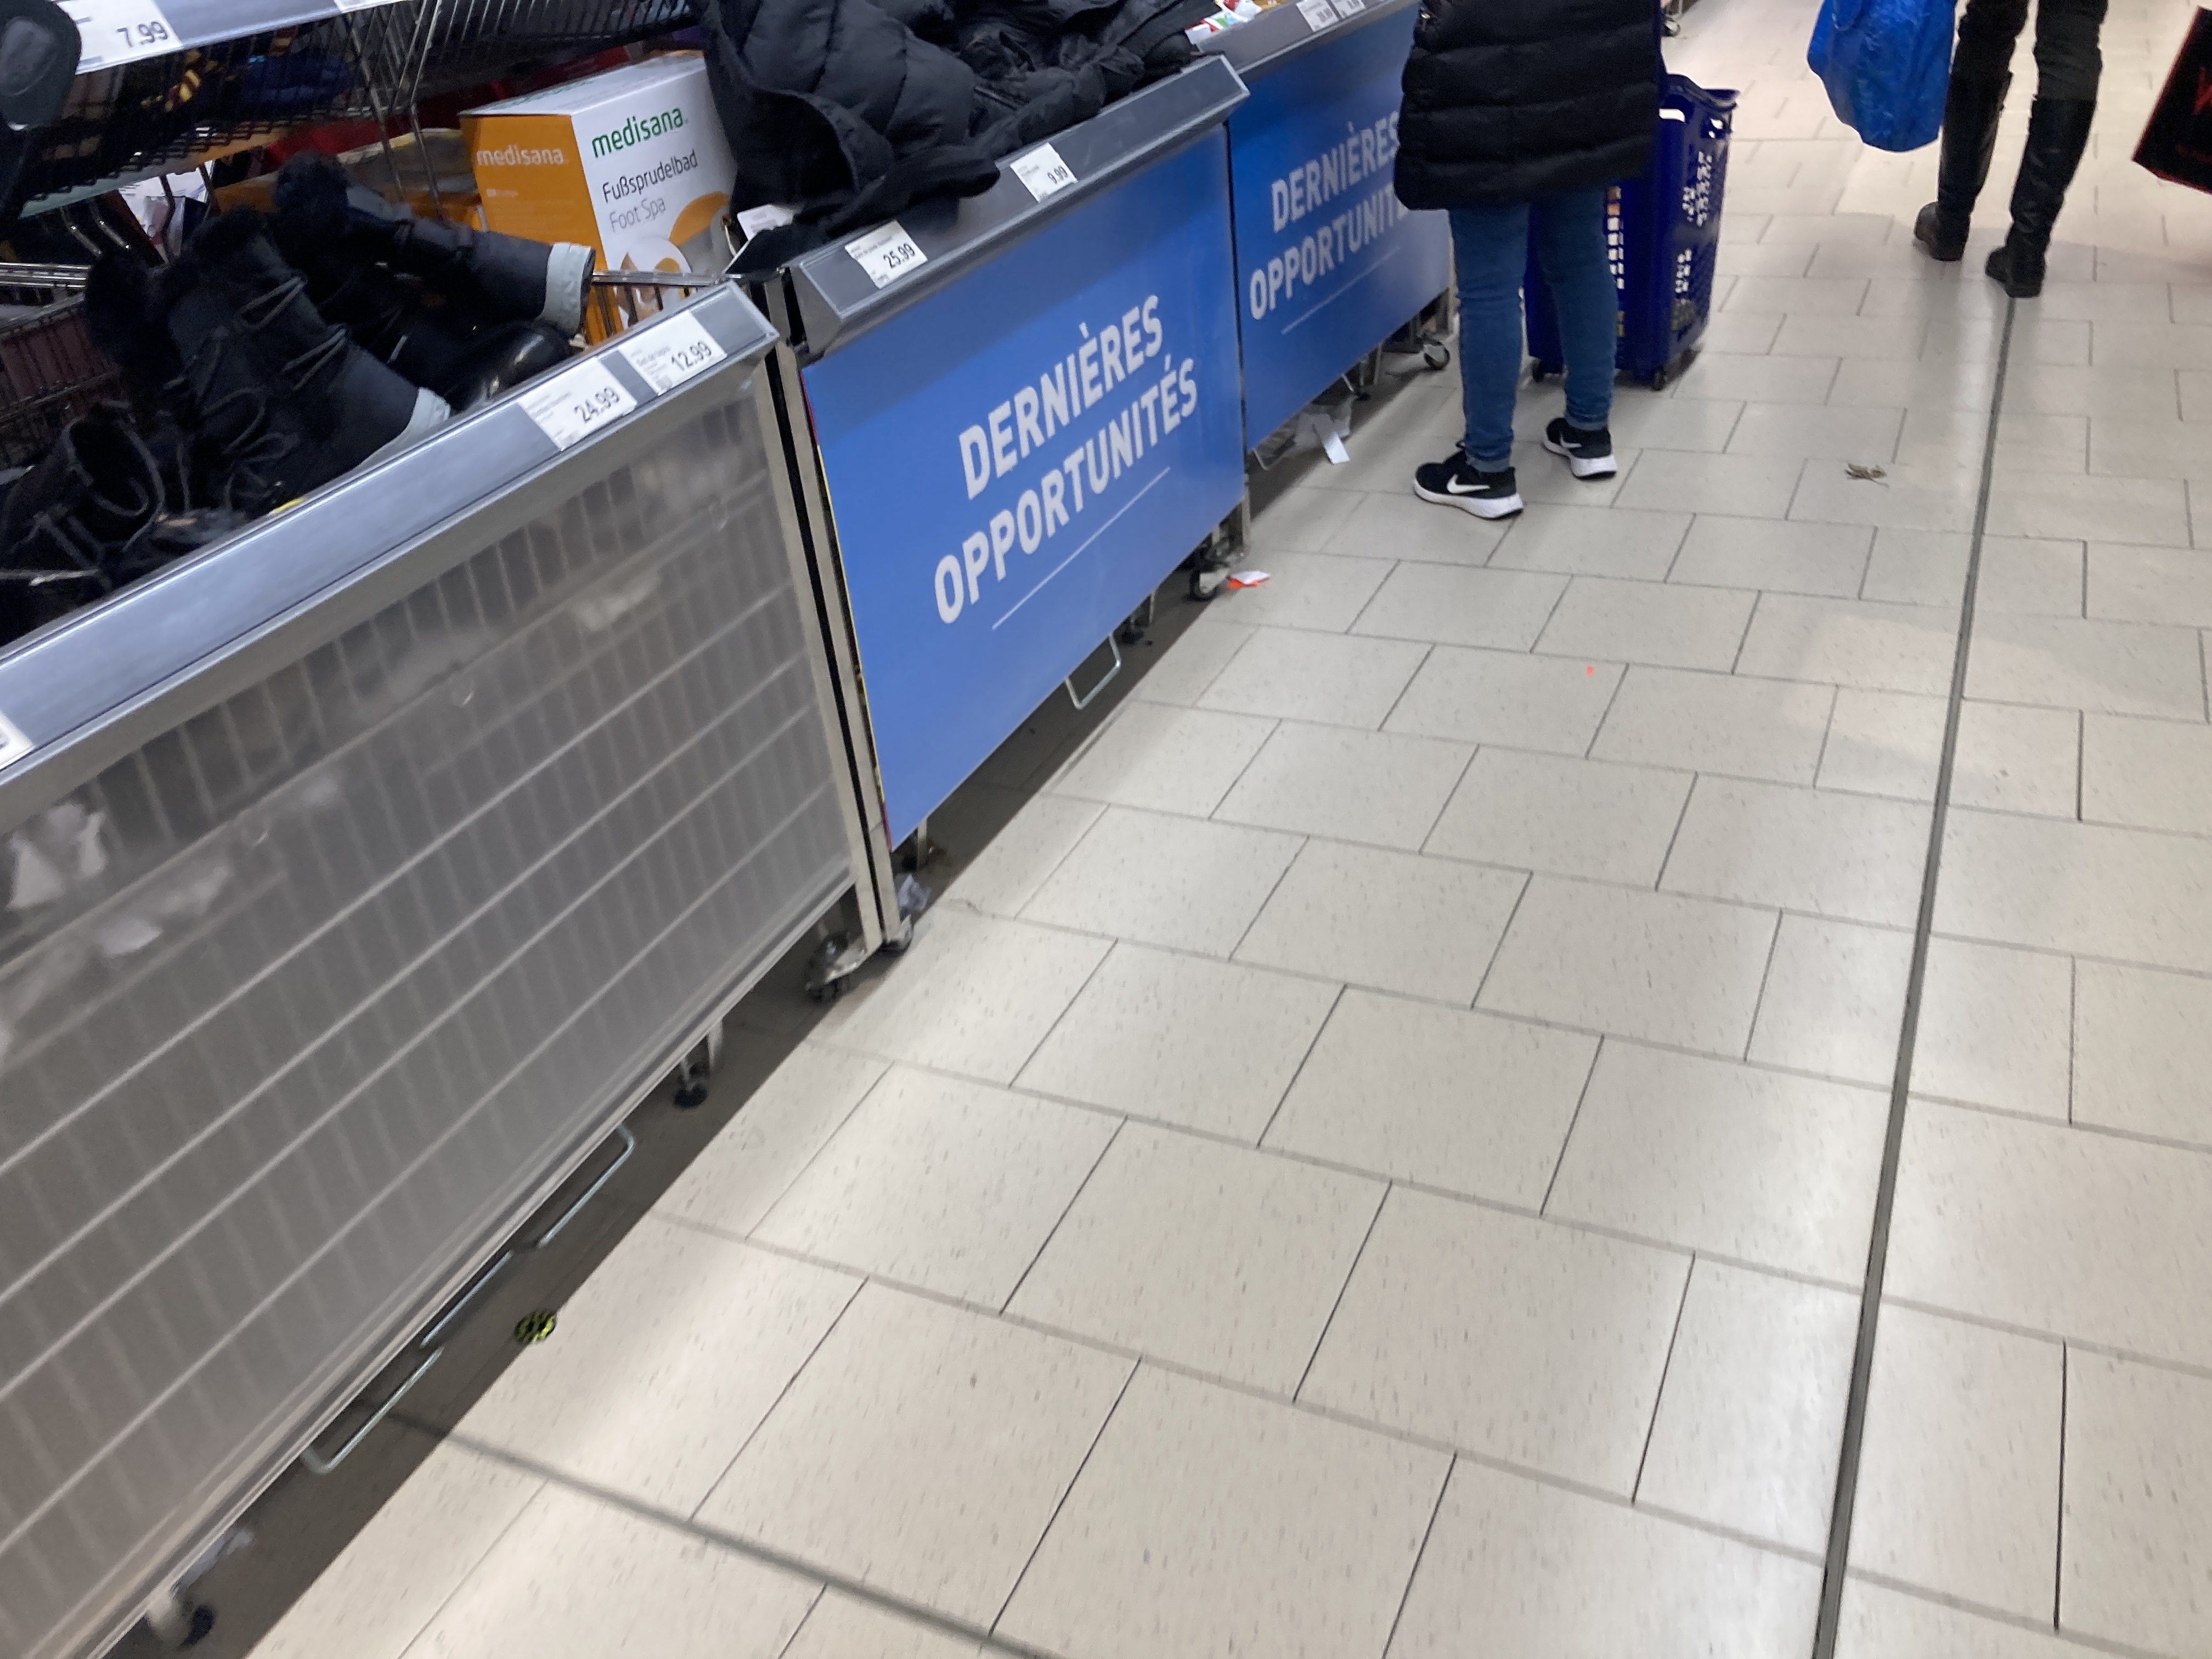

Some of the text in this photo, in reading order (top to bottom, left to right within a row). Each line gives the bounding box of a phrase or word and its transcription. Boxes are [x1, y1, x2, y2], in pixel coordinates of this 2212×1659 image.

[116, 21, 168, 48] 7.99
[591, 106, 684, 159] medisana
[476, 144, 563, 166] medisana
[602, 149, 699, 204] Fußsprudelbad
[609, 196, 667, 233] Foot Spa
[883, 243, 915, 269] 25.99
[1249, 182, 1409, 320] OPPORTUNIT
[671, 341, 712, 371] 12.99
[573, 387, 620, 423] 24.99
[959, 294, 1163, 500] DERNIÈRES
[934, 354, 1197, 624] OPPORTUNITÉS
